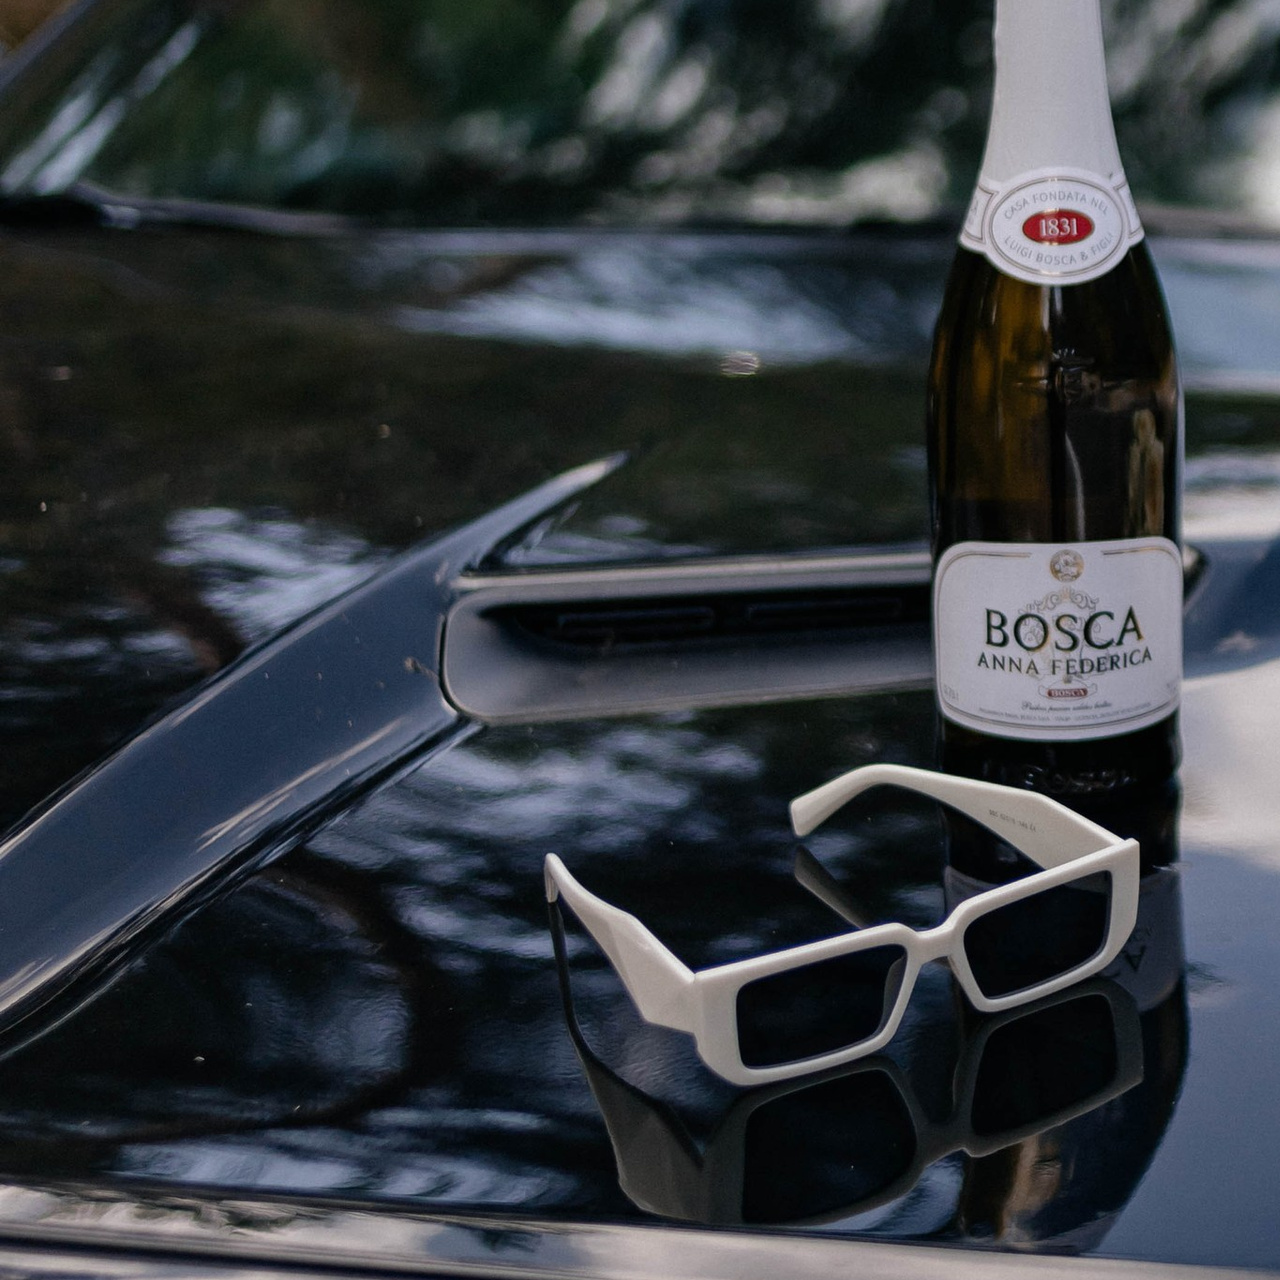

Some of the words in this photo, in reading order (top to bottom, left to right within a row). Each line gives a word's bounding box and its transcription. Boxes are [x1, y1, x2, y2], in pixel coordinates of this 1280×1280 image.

[1004, 198, 1029, 220] CASA
[1032, 191, 1087, 204] FONDATA
[1090, 197, 1108, 216] NEL
[1039, 217, 1078, 237] 1831
[1004, 235, 1033, 259] LUIGI
[1035, 252, 1077, 265] BOSCA
[1081, 251, 1088, 261] &
[1091, 232, 1114, 256] FIGLI
[985, 605, 1145, 652] BOSCA
[977, 652, 1039, 675] ANNA
[1051, 646, 1153, 676] FEDERICA
[1051, 689, 1085, 697] BOSCA
